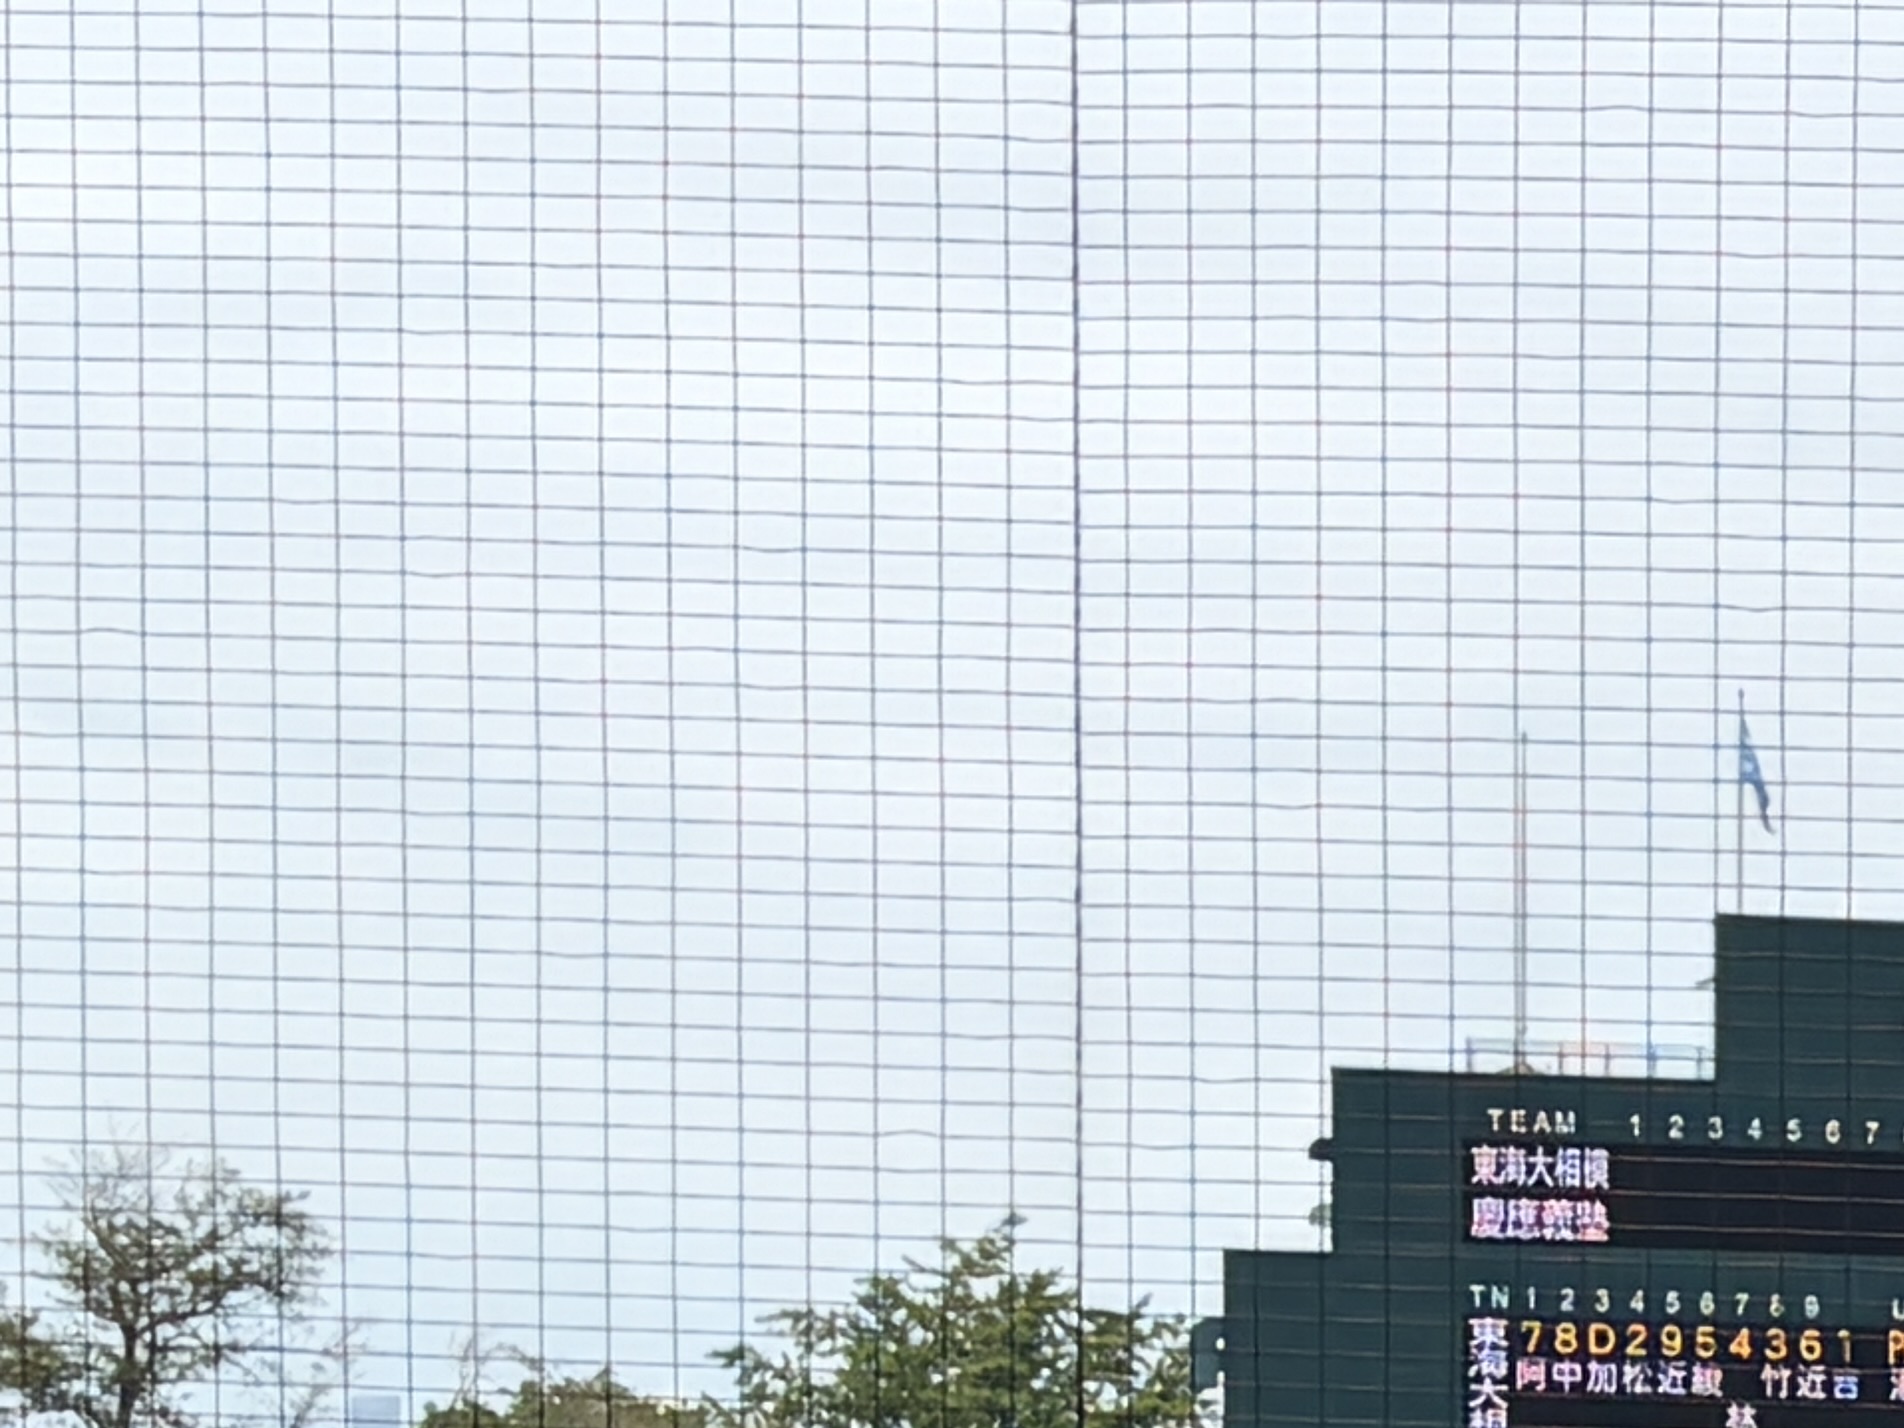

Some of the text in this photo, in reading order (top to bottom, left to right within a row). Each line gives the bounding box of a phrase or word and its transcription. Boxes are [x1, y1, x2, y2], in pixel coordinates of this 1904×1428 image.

[1488, 1109, 1575, 1133] TEAM
[1629, 1114, 1640, 1137] 1
[1668, 1114, 1684, 1139] 2
[1708, 1116, 1724, 1139] 3
[1747, 1117, 1763, 1140] 4
[1786, 1118, 1802, 1143] 5
[1825, 1119, 1841, 1144] 6
[1865, 1120, 1880, 1145] 7
[1471, 1145, 1609, 1189] 東海大相模
[1471, 1197, 1610, 1241] 慶應義塾
[1527, 1286, 1536, 1310] 1
[1560, 1287, 1575, 1312] 2
[1594, 1288, 1610, 1313] 3
[1629, 1289, 1645, 1313] 4
[1665, 1290, 1681, 1315] 5
[1735, 1292, 1750, 1316] 7
[1521, 1320, 1852, 1364] 7 8 D 2 9 5 4 3 6 1
